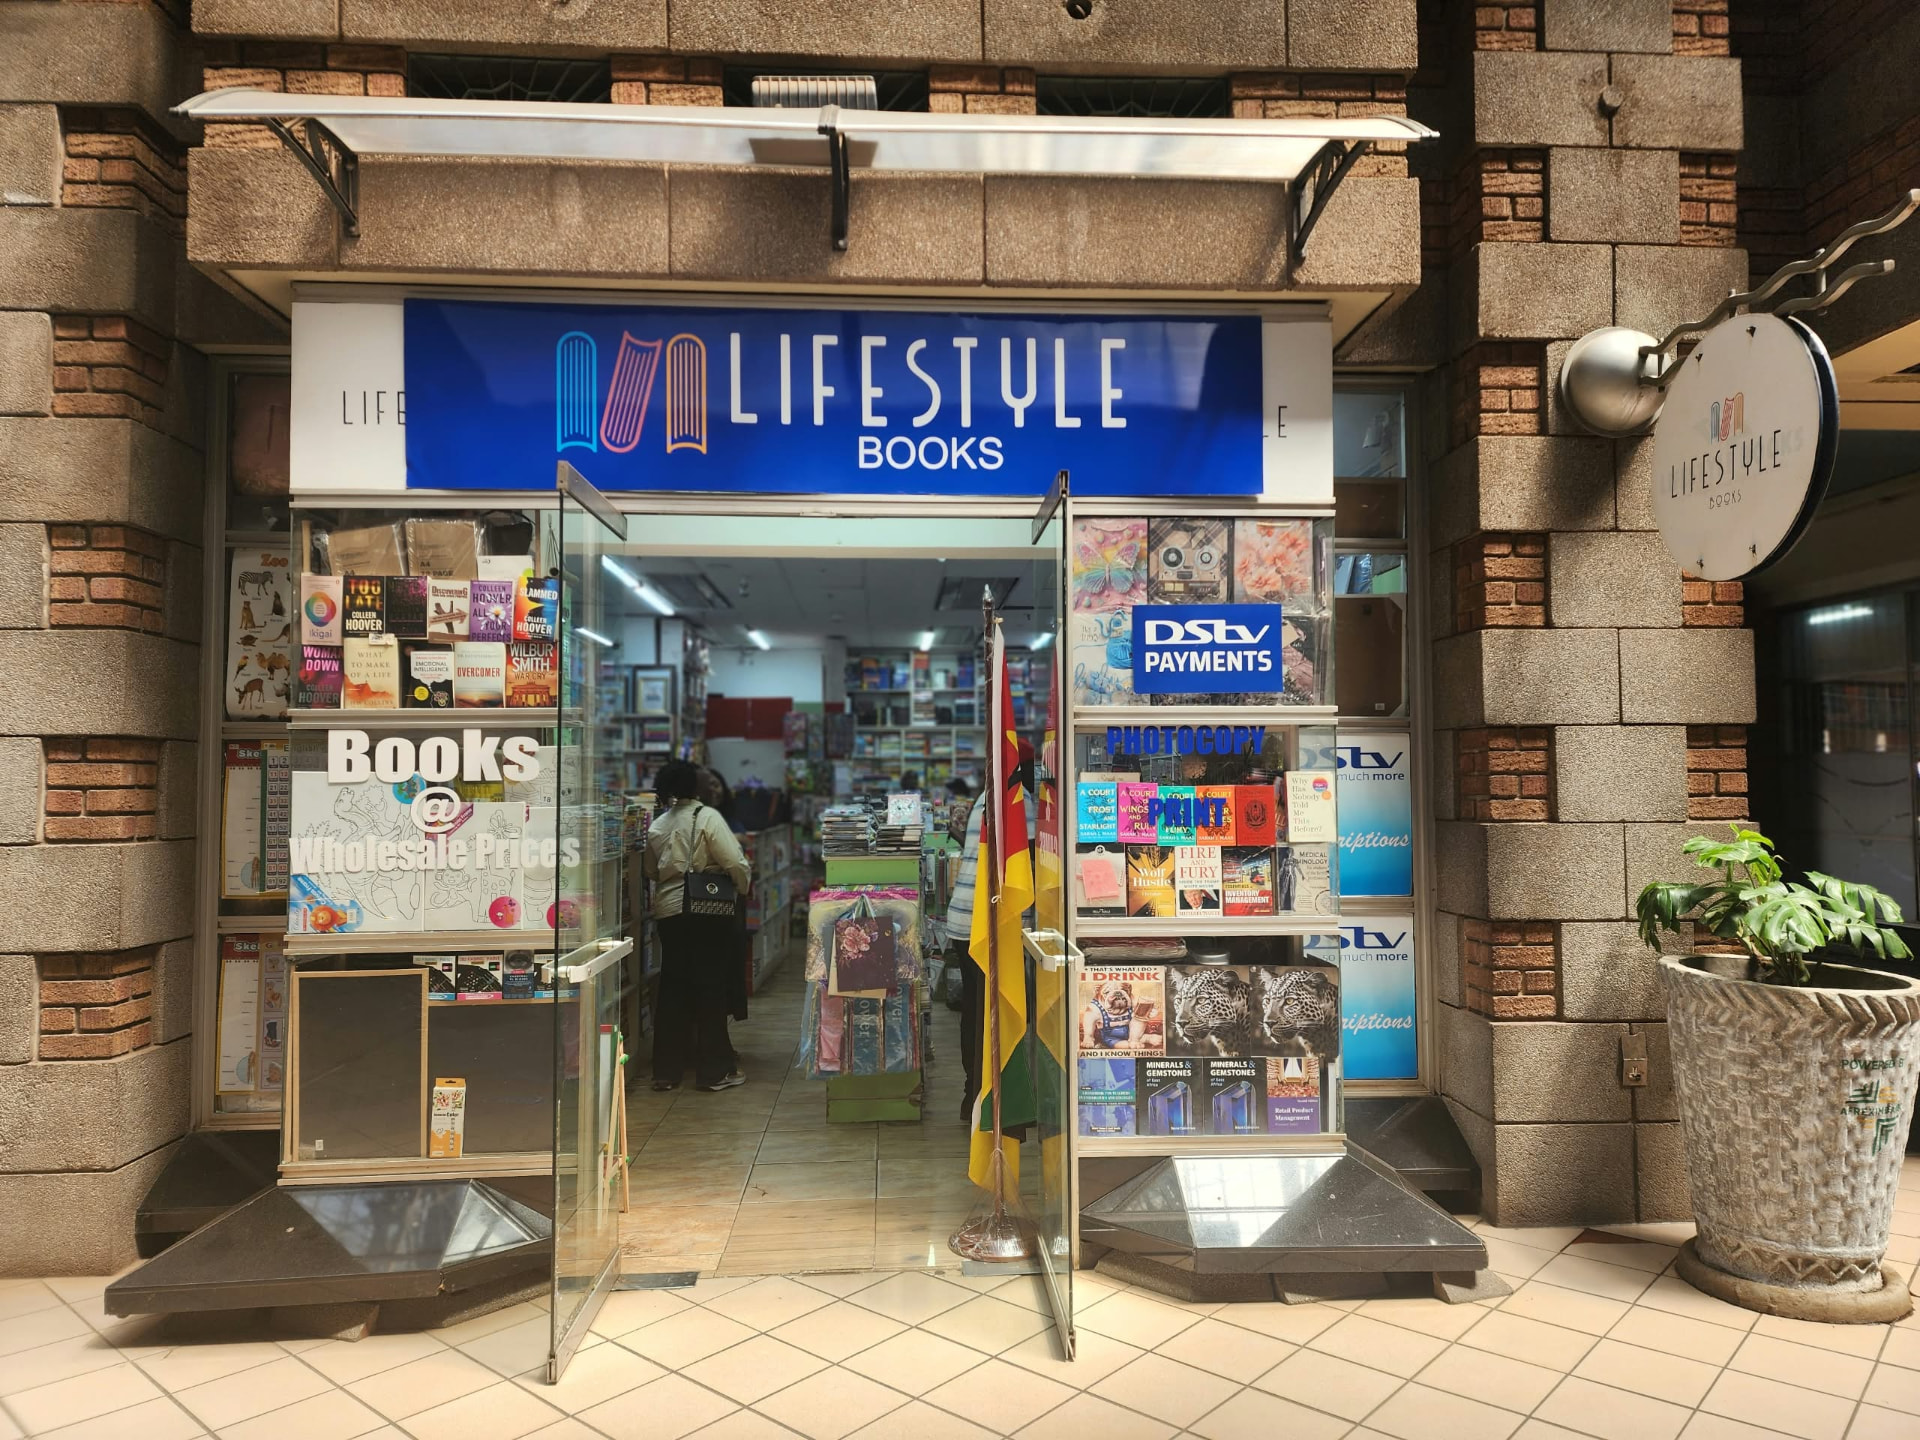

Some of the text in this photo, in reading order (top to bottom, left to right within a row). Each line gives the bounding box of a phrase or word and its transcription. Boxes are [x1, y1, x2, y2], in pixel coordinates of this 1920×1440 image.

[730, 332, 1127, 429] LIFESTYLE
[858, 435, 1004, 470] BOOKS
[1671, 429, 1781, 499] LIFESTYLE
[1709, 489, 1742, 510] BOOKS
[260, 553, 288, 567] Zoo
[347, 579, 381, 595] TOO
[472, 593, 511, 604] HOOVER
[519, 587, 558, 600] SLAMMED
[352, 611, 376, 619] COLLEEN
[472, 608, 488, 618] ALL
[524, 615, 547, 623] COLLEEN
[345, 619, 383, 631] HOOVER
[485, 621, 507, 631] YOUR
[516, 621, 553, 635] HOOVER
[309, 629, 332, 639] Ikigai
[471, 632, 511, 642] PERFECTS
[1144, 619, 1270, 646] DStv
[510, 643, 553, 658] WILBUR
[306, 659, 339, 671] DOWN
[512, 658, 550, 672] SMITH
[1144, 650, 1272, 673] PAYMENTS
[457, 666, 501, 678] OVERCOMER
[306, 684, 333, 692] COLLEEN
[298, 691, 339, 704] HOOVER
[1106, 725, 1266, 756] PHOTOCOPY
[326, 728, 540, 783] Books
[1292, 777, 1308, 786] Why
[1337, 772, 1405, 781] much more
[410, 786, 461, 834] @
[1148, 797, 1227, 827] PRINT
[289, 831, 580, 874] Wholesale Prices
[1180, 847, 1216, 859] FIRE
[1139, 867, 1166, 878] Wolf
[1180, 866, 1218, 878] FURY
[1133, 877, 1171, 887] Hustle
[1376, 953, 1409, 961] more
[1081, 972, 1160, 981] I DRINK
[1184, 1060, 1192, 1069] &
[1248, 1060, 1256, 1069] &
[1146, 1069, 1192, 1077] GEMSTONES
[1210, 1069, 1256, 1077] GEMSTONES
